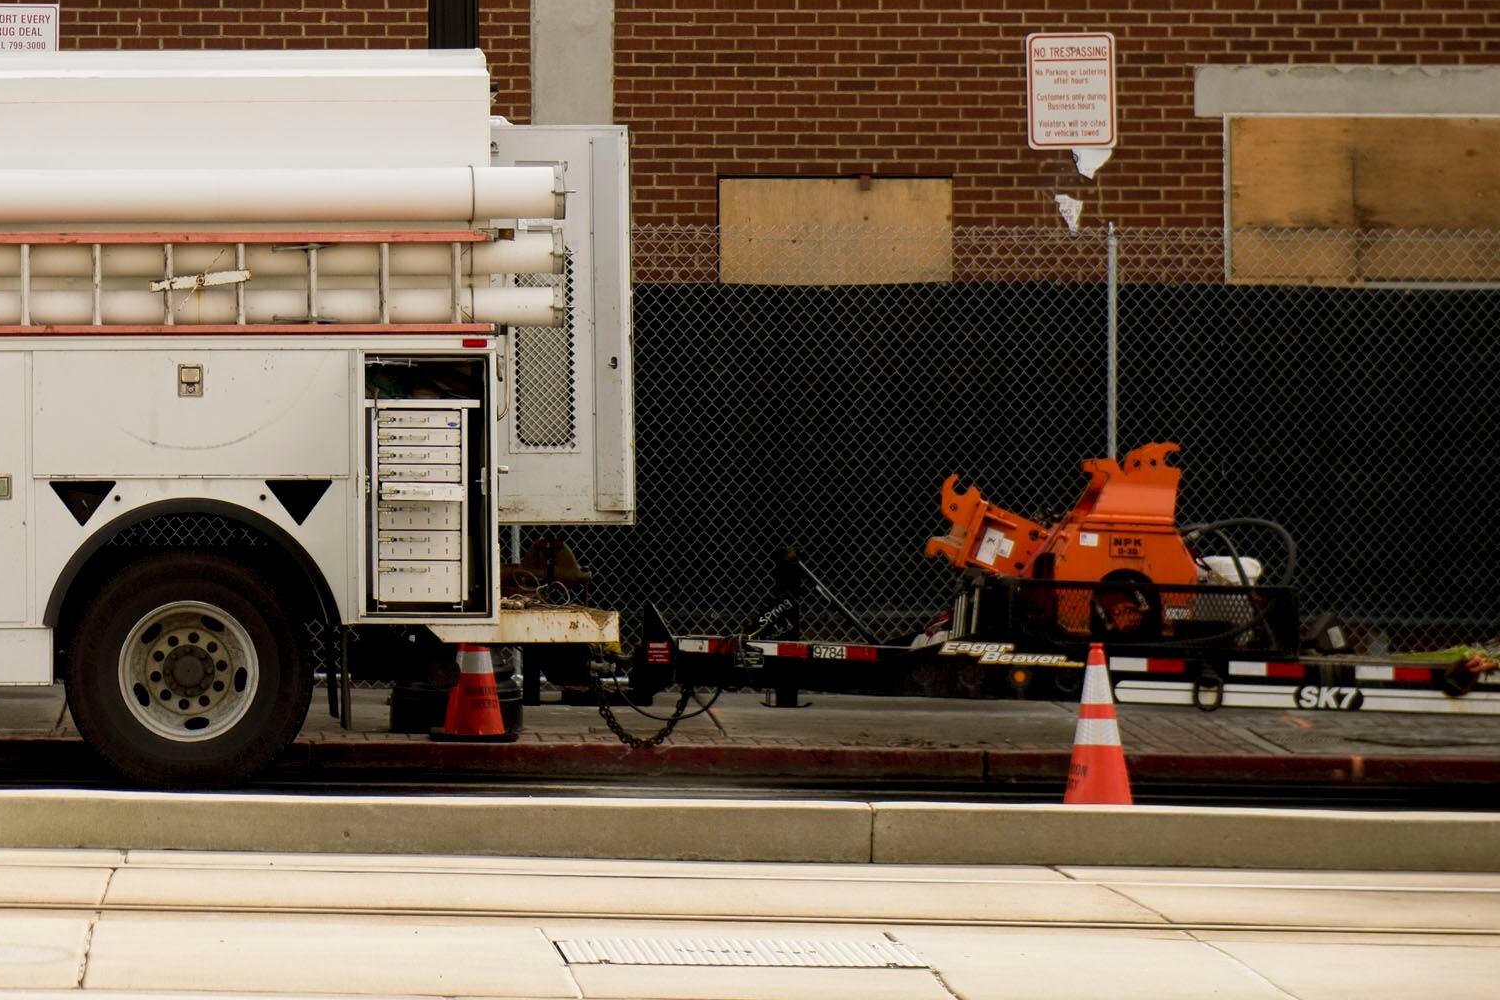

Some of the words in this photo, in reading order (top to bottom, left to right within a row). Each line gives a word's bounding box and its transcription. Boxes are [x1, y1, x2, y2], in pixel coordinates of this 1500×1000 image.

[21, 15, 51, 24] EVERY
[19, 27, 43, 36] DEAL
[9, 41, 46, 50] 799-3000
[1034, 48, 1046, 57] NO
[1050, 47, 1107, 57] TRESPASSING
[1045, 69, 1069, 77] Parking
[1079, 68, 1107, 76] Loitering
[1037, 93, 1070, 101] Customers
[1072, 93, 1085, 101] only
[1087, 93, 1107, 101] during
[1077, 102, 1095, 110] hours
[1038, 120, 1066, 128] Violators
[1054, 129, 1079, 137] vehicles
[1114, 538, 1142, 547] NPK
[759, 599, 793, 626] Spring
[814, 646, 845, 658] 9784
[940, 642, 1014, 656] Eager
[979, 651, 1066, 665] Beaver
[1299, 686, 1357, 709] SK7
